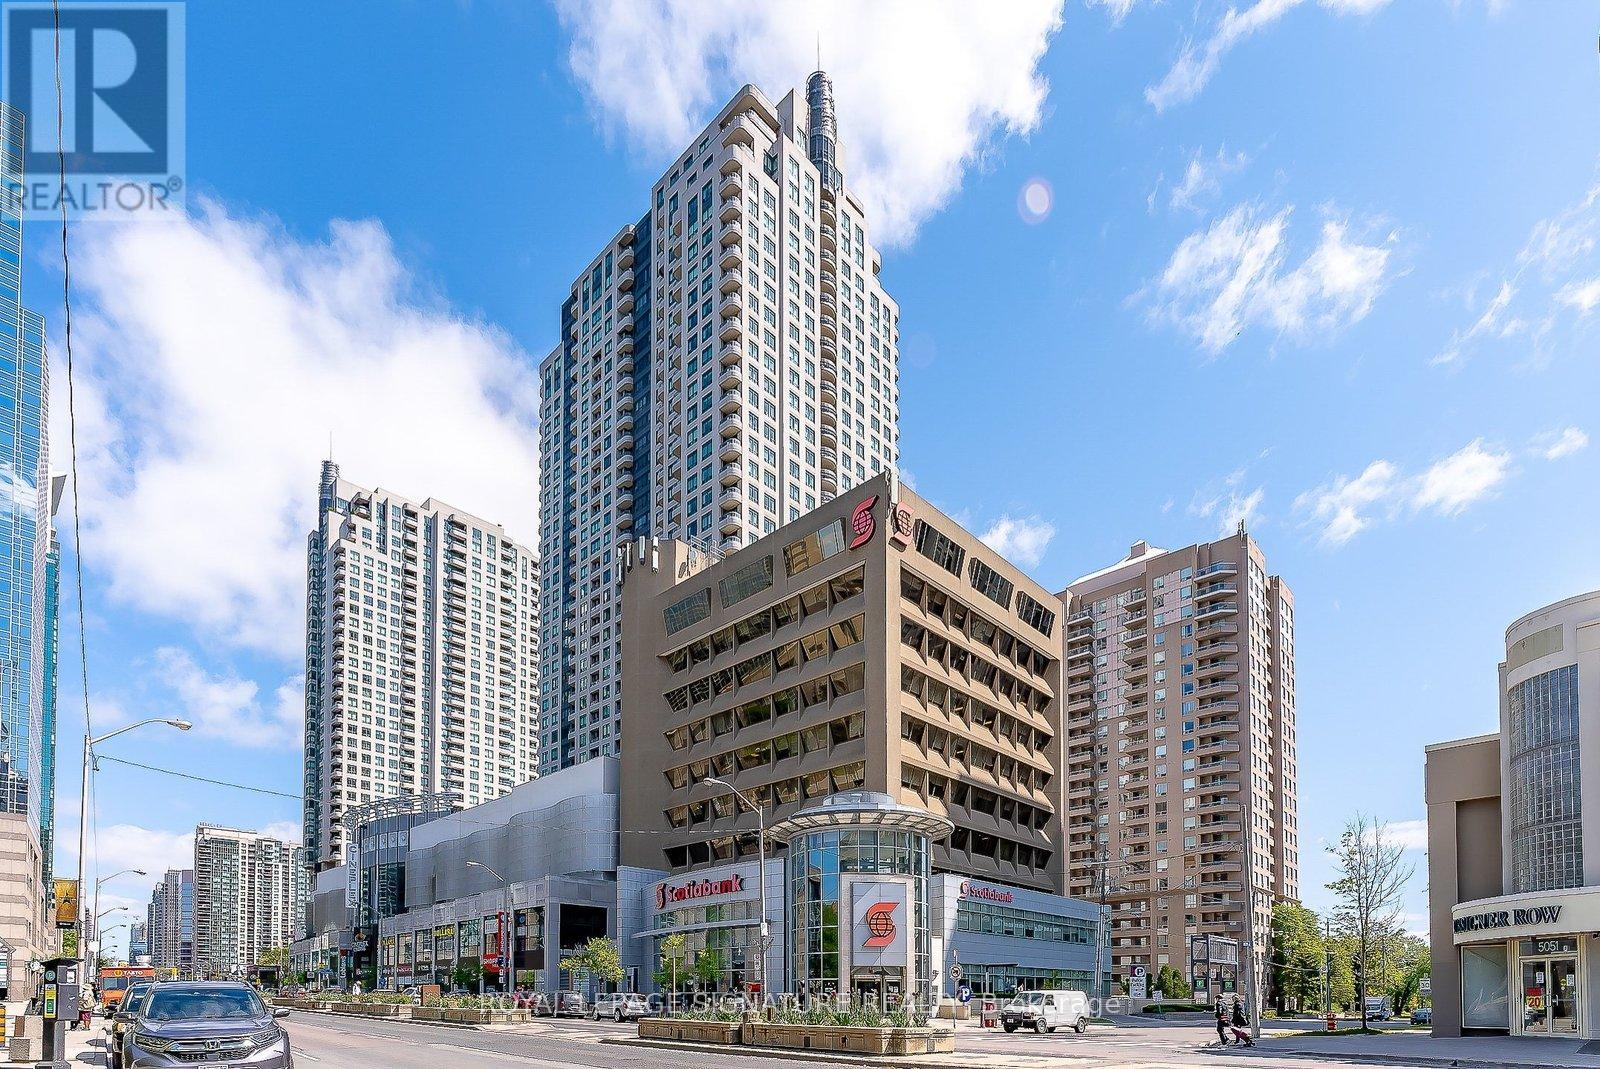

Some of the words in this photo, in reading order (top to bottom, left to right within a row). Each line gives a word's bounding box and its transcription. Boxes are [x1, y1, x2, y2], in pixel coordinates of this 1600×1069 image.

[668, 873, 744, 902] Scotiabank
[969, 885, 1014, 904] Scotiabank
[1513, 905, 1562, 926] ROW
[1538, 941, 1559, 953] 5051
